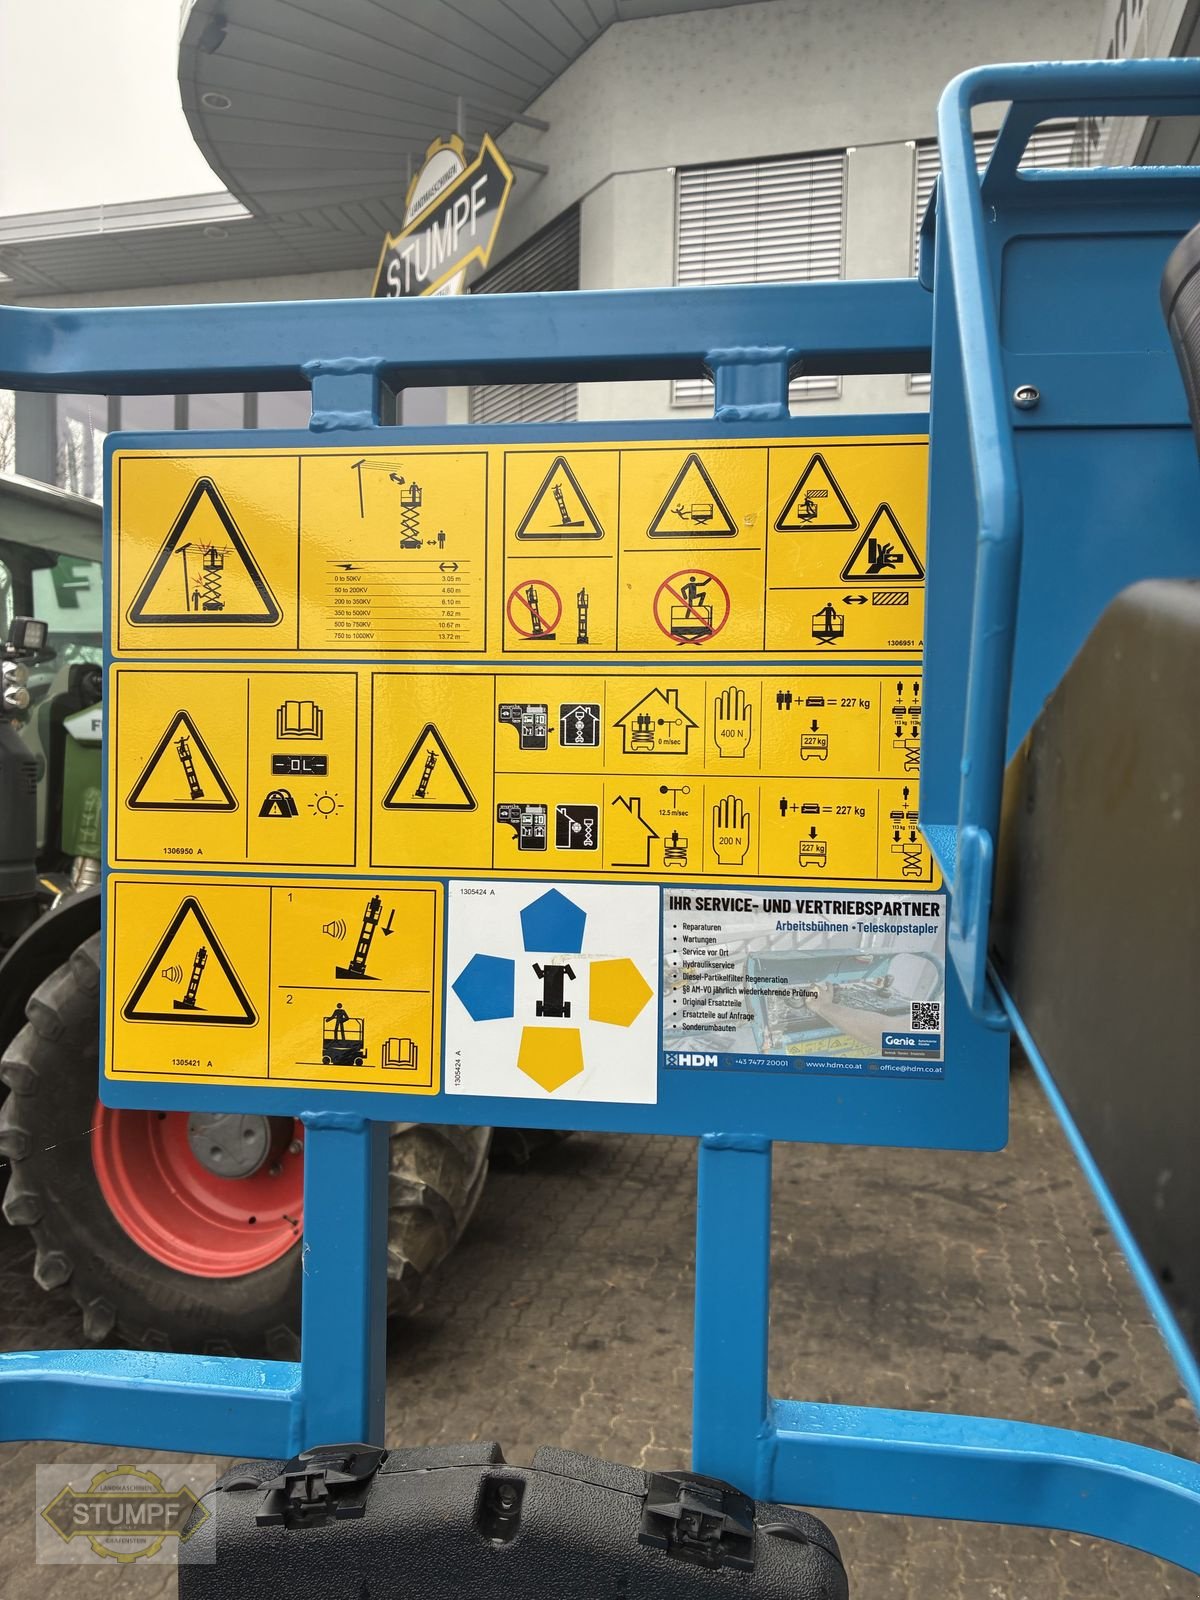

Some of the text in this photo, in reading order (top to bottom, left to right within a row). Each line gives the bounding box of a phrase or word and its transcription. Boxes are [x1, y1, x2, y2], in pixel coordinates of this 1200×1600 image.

[386, 173, 488, 298] STUMPF
[840, 698, 870, 710] 227 kg
[720, 729, 744, 738] 400 N
[804, 737, 826, 747] 227 kg
[836, 806, 866, 818] 227 kg
[719, 837, 742, 846] 200 N
[802, 844, 824, 855] 227 kg
[288, 893, 292, 902] 1
[669, 896, 940, 917] IHR SERVICE- UND VERTRIEBSPARTNER
[682, 923, 722, 932] Reparaturen
[776, 920, 938, 936] Arbeitsbühnen Teleskopstapler
[682, 936, 717, 945] Wartungen
[682, 948, 706, 956] Service
[720, 949, 729, 957] Ort
[682, 960, 735, 970] Hydraulikservice
[682, 973, 788, 984] Diesel-Partikelfilter Regeneration
[682, 986, 690, 994] §8
[713, 986, 738, 996] jährlich
[739, 988, 790, 997] wiederkehrende
[792, 988, 819, 999] Prüfung
[286, 994, 292, 1004] 2
[682, 998, 742, 1008] Original Ersatzteile
[682, 1010, 716, 1019] Ersatzteile
[730, 1012, 754, 1021] Anfrage
[682, 1023, 736, 1032] Sonderumbauten
[885, 1036, 916, 1046] Genie
[679, 1054, 718, 1067] HDM
[806, 1062, 862, 1070] www.hdm.co.at
[880, 1065, 942, 1073] office@hdm.co.at
